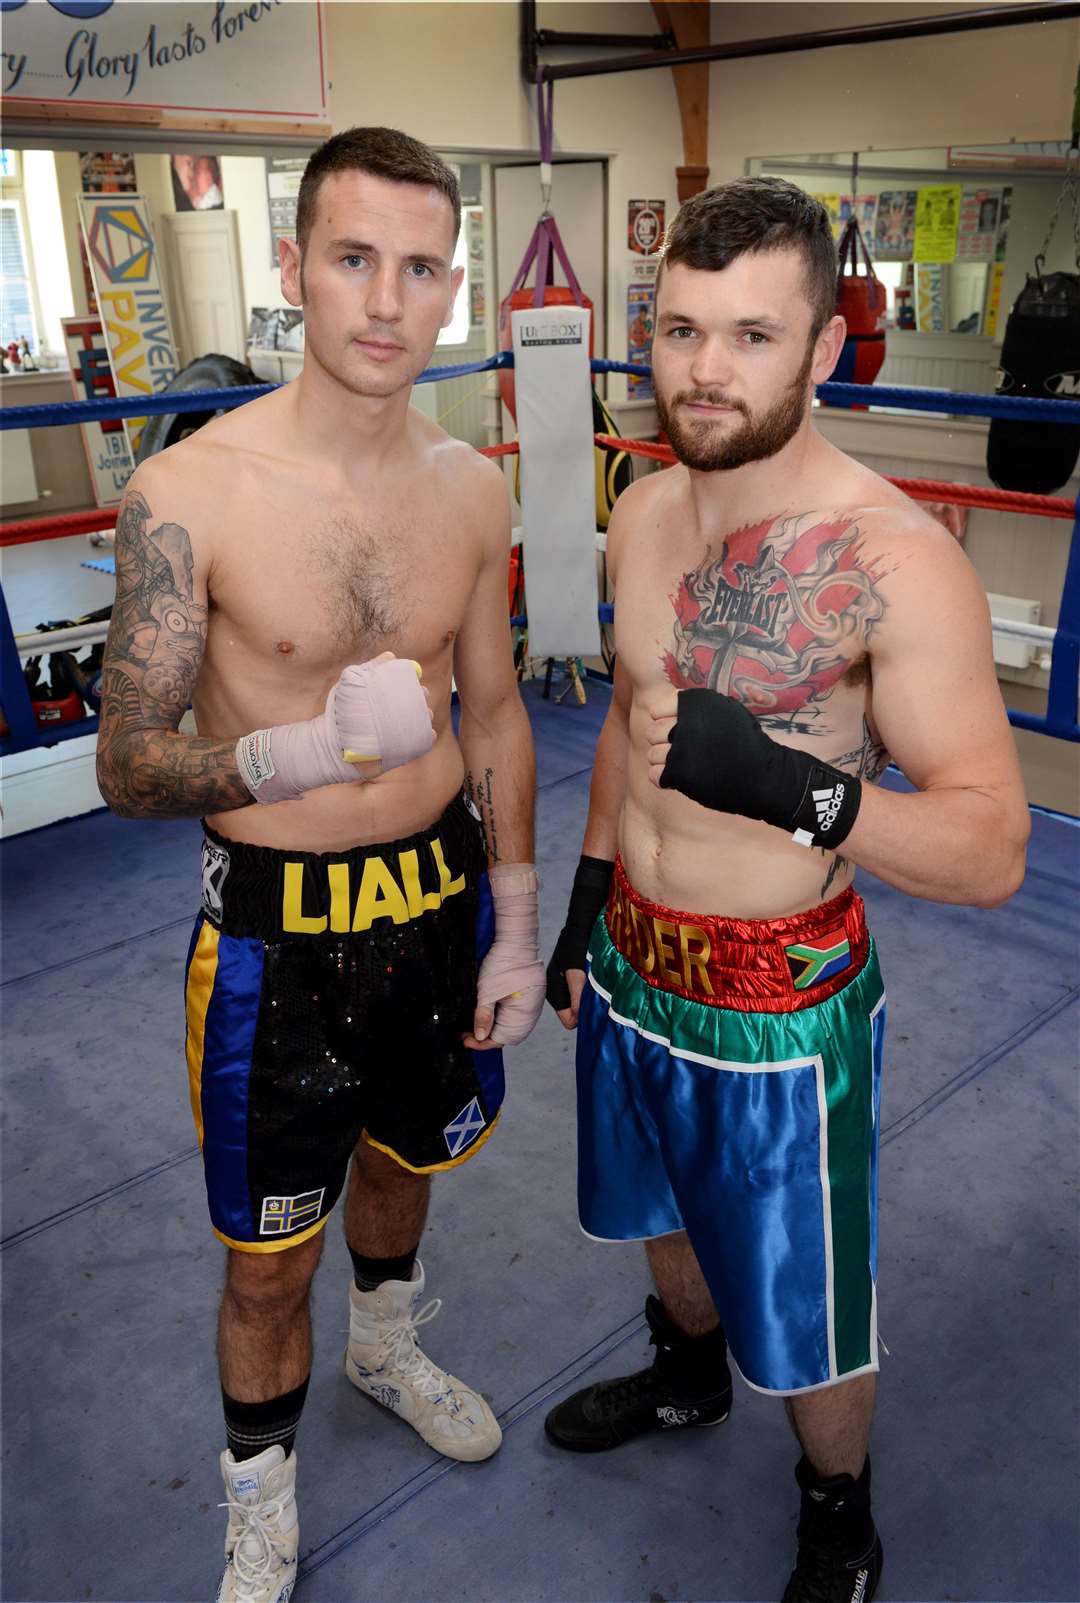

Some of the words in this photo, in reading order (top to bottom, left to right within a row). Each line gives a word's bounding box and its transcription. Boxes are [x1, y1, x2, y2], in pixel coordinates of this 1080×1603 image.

[65, 29, 139, 96] Glory
[143, 24, 206, 68] lasts
[820, 783, 846, 832] adidas
[282, 837, 466, 934] LIALL
